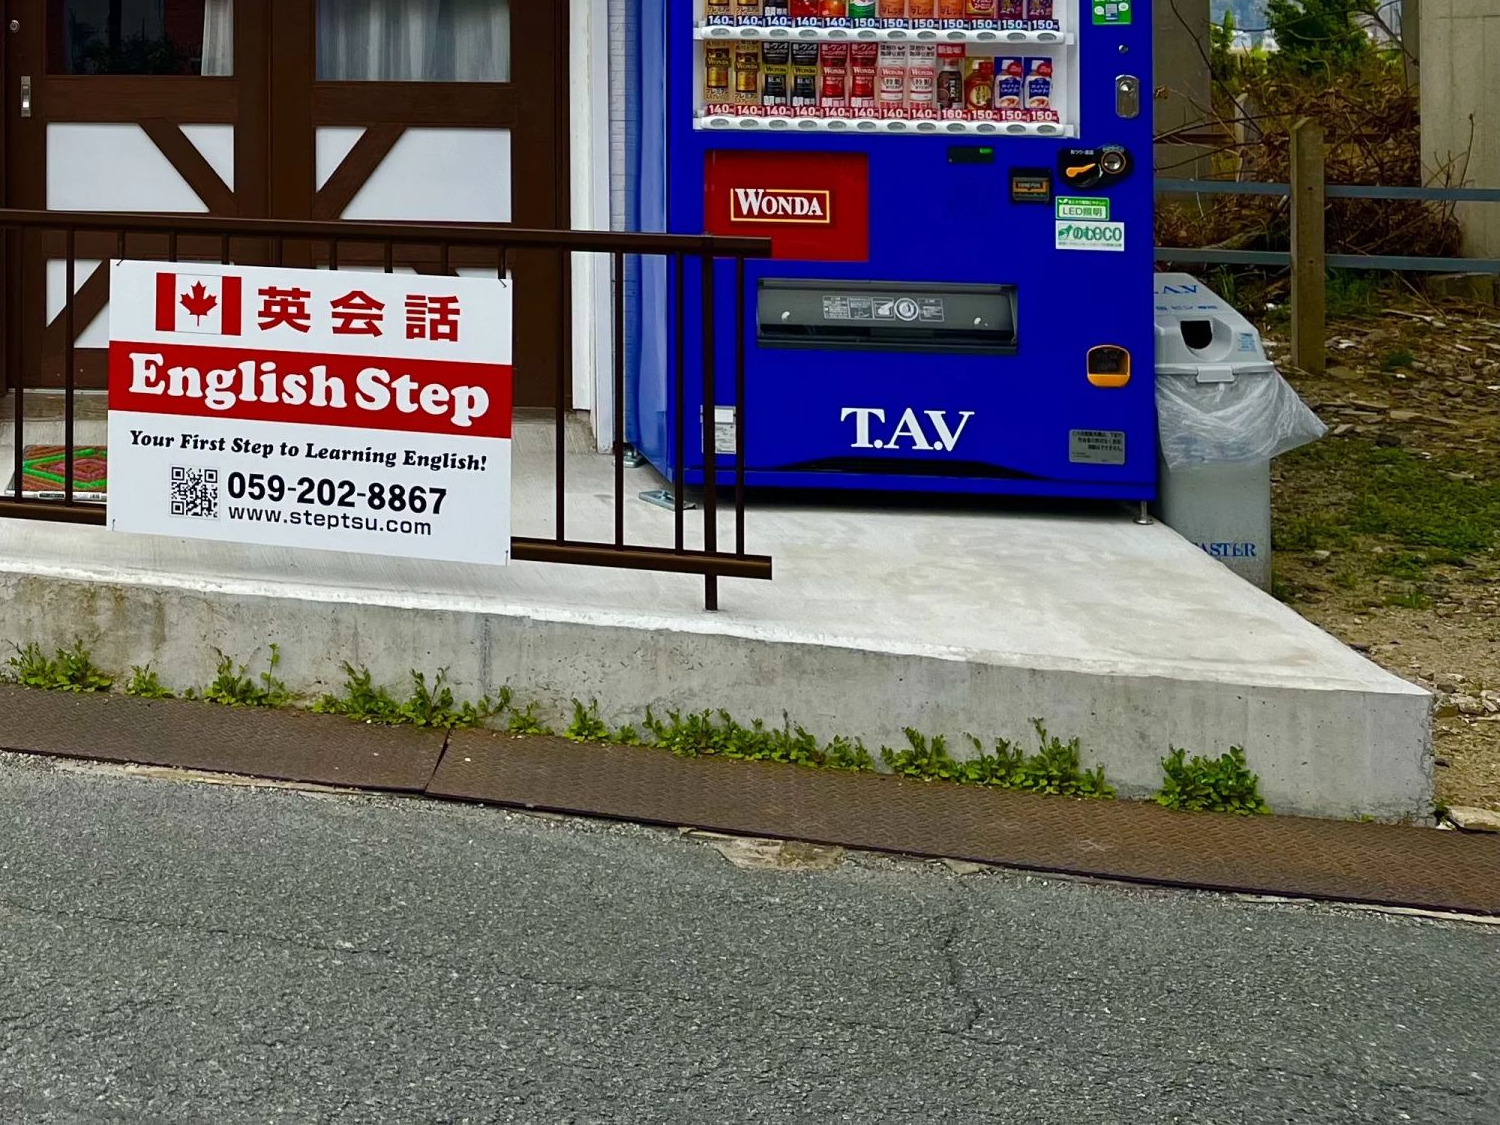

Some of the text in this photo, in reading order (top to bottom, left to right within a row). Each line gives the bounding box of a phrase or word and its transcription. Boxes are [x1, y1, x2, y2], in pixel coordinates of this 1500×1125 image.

[735, 188, 824, 216] WONDA
[1062, 207, 1103, 217] LED照明
[129, 352, 491, 428] English Step
[840, 407, 976, 452] T.A.V
[130, 430, 488, 472] Your First Step to Learning English!
[227, 471, 448, 515] 059-202-8867
[228, 505, 432, 536] www.steptsu.com
